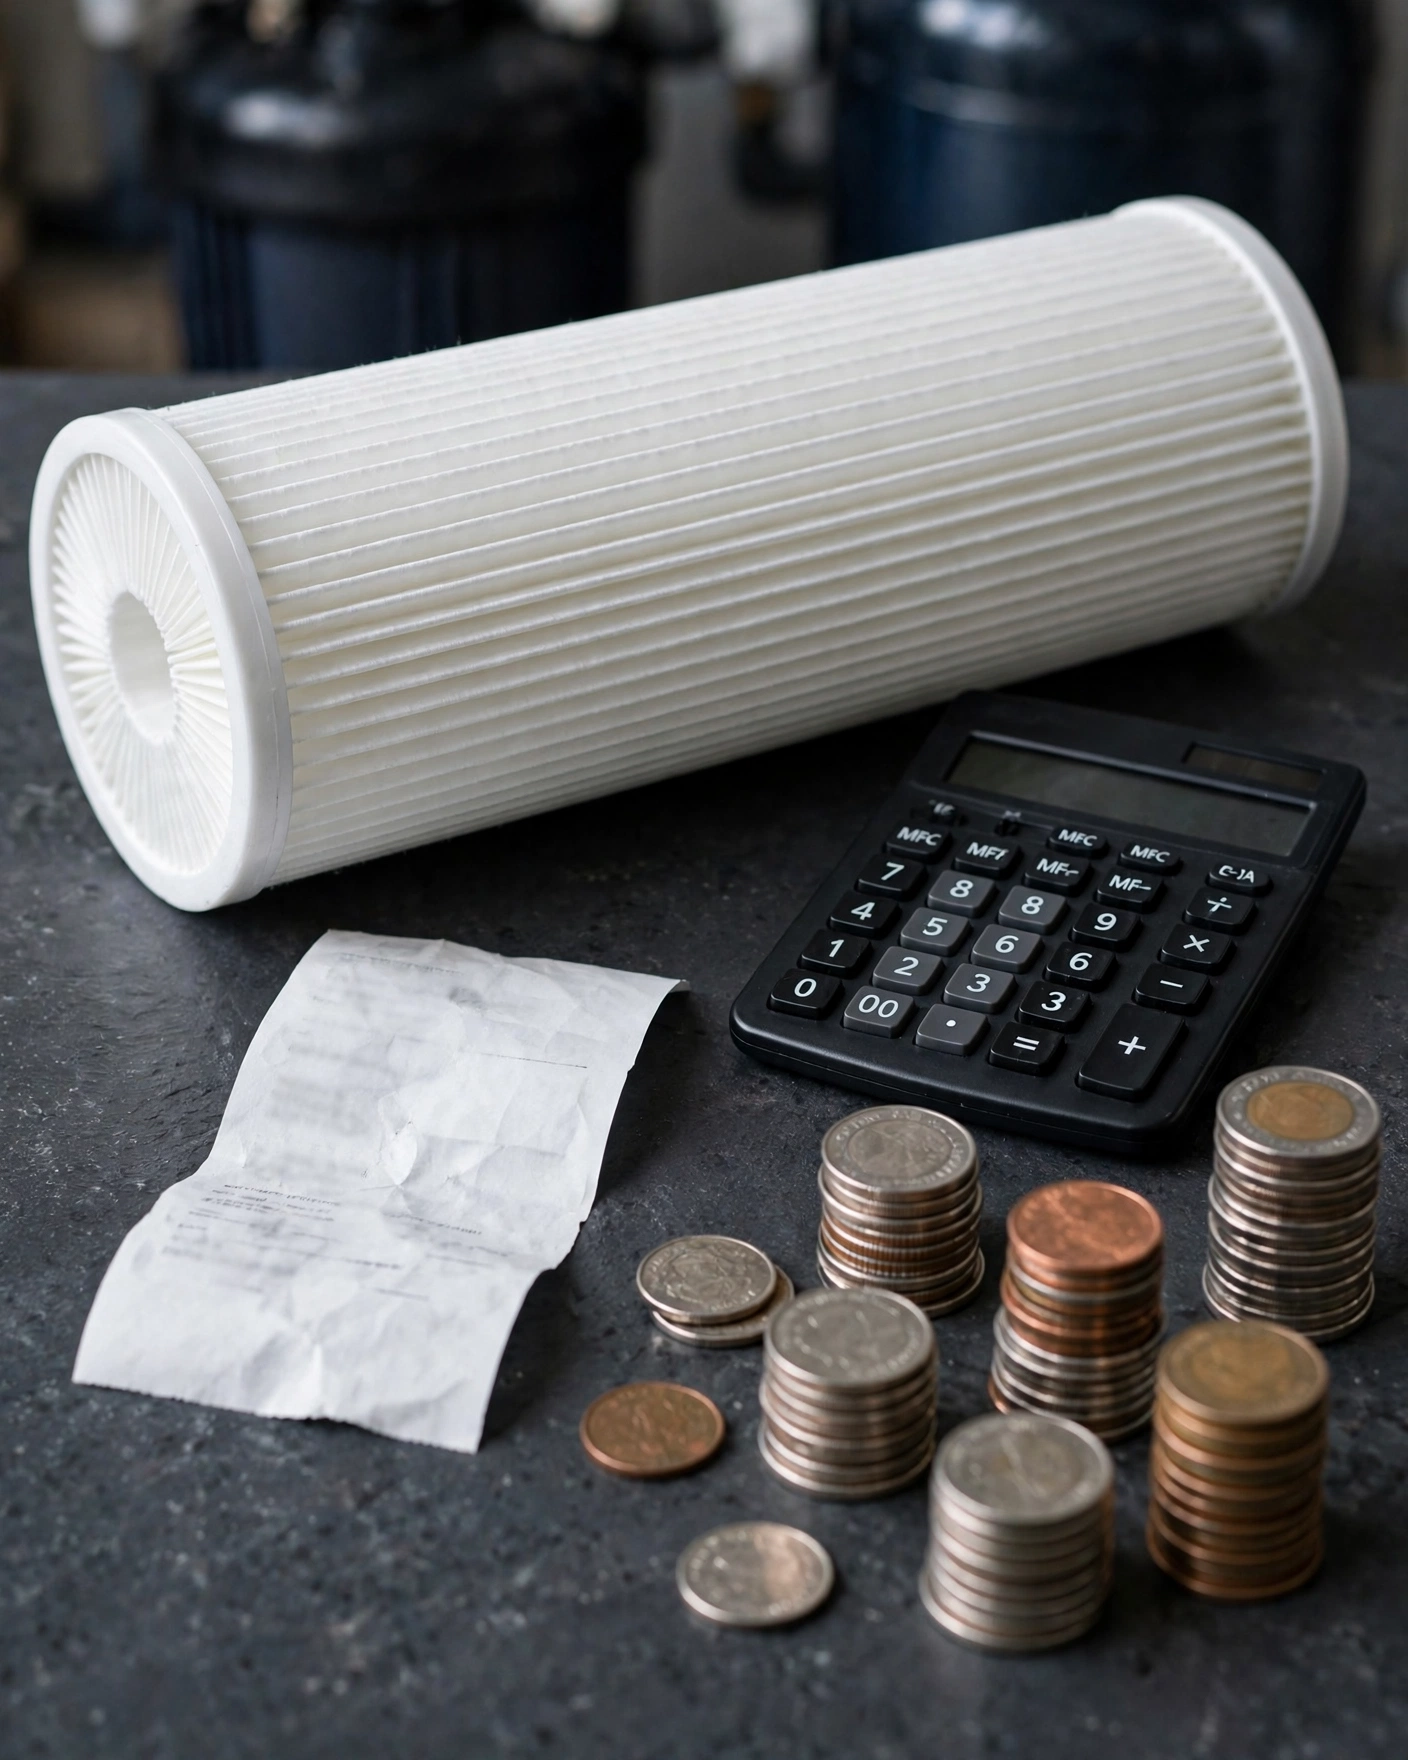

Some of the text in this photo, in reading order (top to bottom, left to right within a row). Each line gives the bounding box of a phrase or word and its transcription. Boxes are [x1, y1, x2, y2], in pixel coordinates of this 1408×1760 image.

[897, 826, 942, 846] MFC
[881, 861, 905, 881] 7
[949, 879, 974, 898] 8
[850, 901, 875, 921] 4
[1021, 895, 1044, 915] 8
[922, 917, 948, 937] 5
[1094, 912, 1117, 931] 9
[828, 939, 845, 958] 1
[995, 935, 1019, 954] 6
[893, 956, 919, 977] 2
[1069, 952, 1093, 971] 6
[794, 978, 817, 998] 0
[966, 973, 991, 993] 3
[858, 994, 899, 1018] 00
[1041, 991, 1067, 1012] 3
